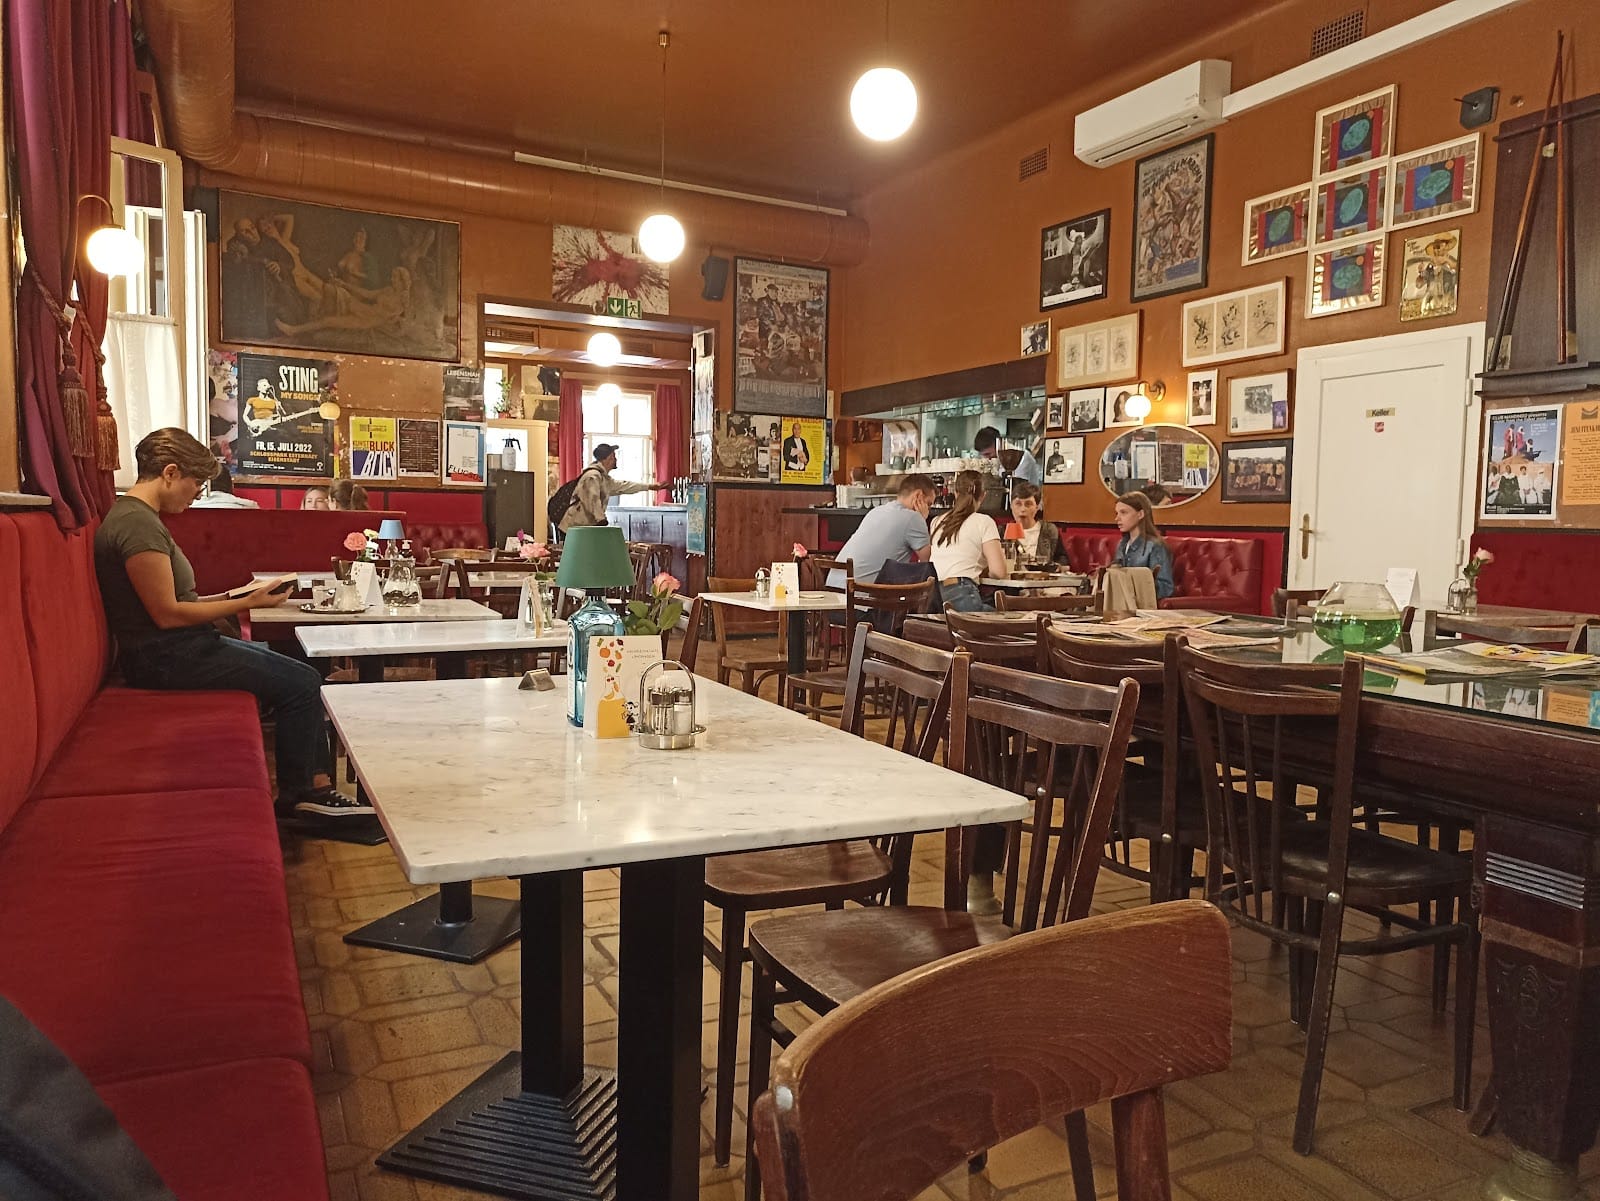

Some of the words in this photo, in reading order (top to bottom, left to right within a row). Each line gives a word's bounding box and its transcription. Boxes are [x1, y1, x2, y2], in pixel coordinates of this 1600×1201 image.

[279, 365, 318, 393] STING
[1371, 408, 1389, 417] Keller
[267, 442, 276, 451] 15.
[277, 442, 293, 452] JULI
[294, 443, 312, 453] 2022
[369, 440, 395, 452] BLICK
